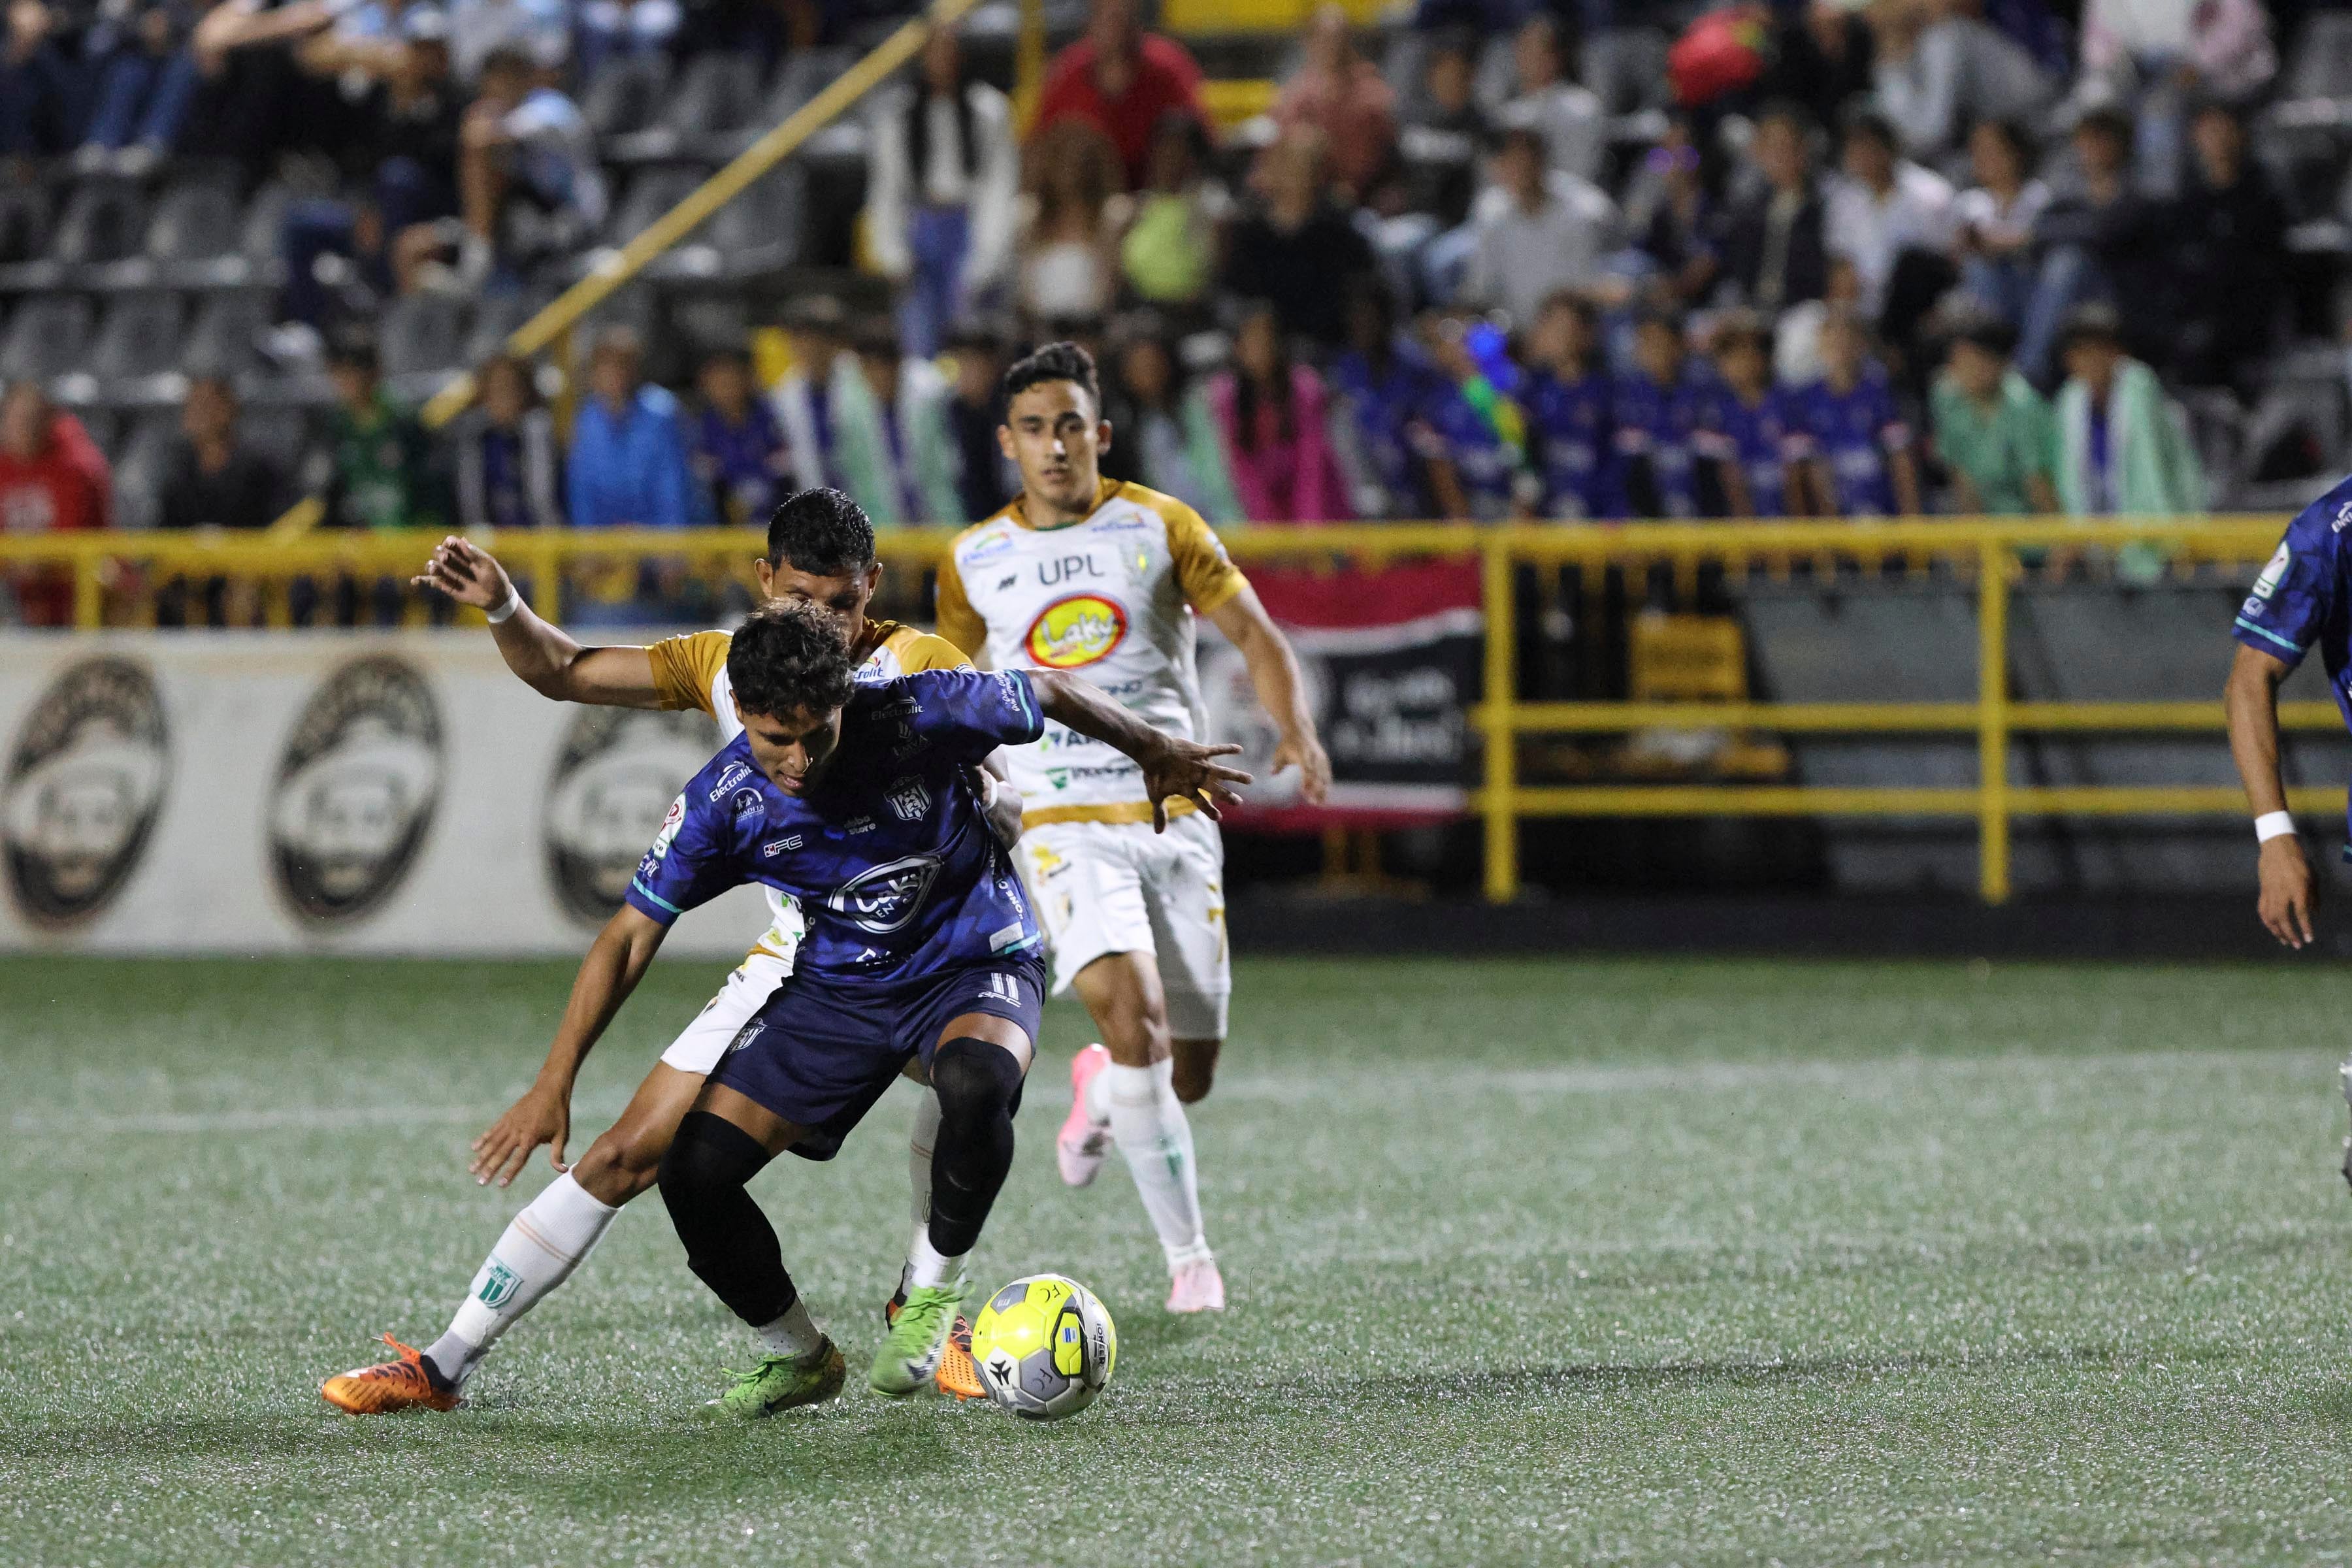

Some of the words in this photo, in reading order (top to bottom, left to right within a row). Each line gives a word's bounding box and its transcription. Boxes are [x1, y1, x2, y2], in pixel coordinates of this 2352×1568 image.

[1037, 553, 1105, 586] UPL
[854, 667, 885, 679] rolit
[710, 765, 753, 802] Electrolit
[990, 972, 1019, 1001] 11
[1096, 1323, 1105, 1365] IONEER
